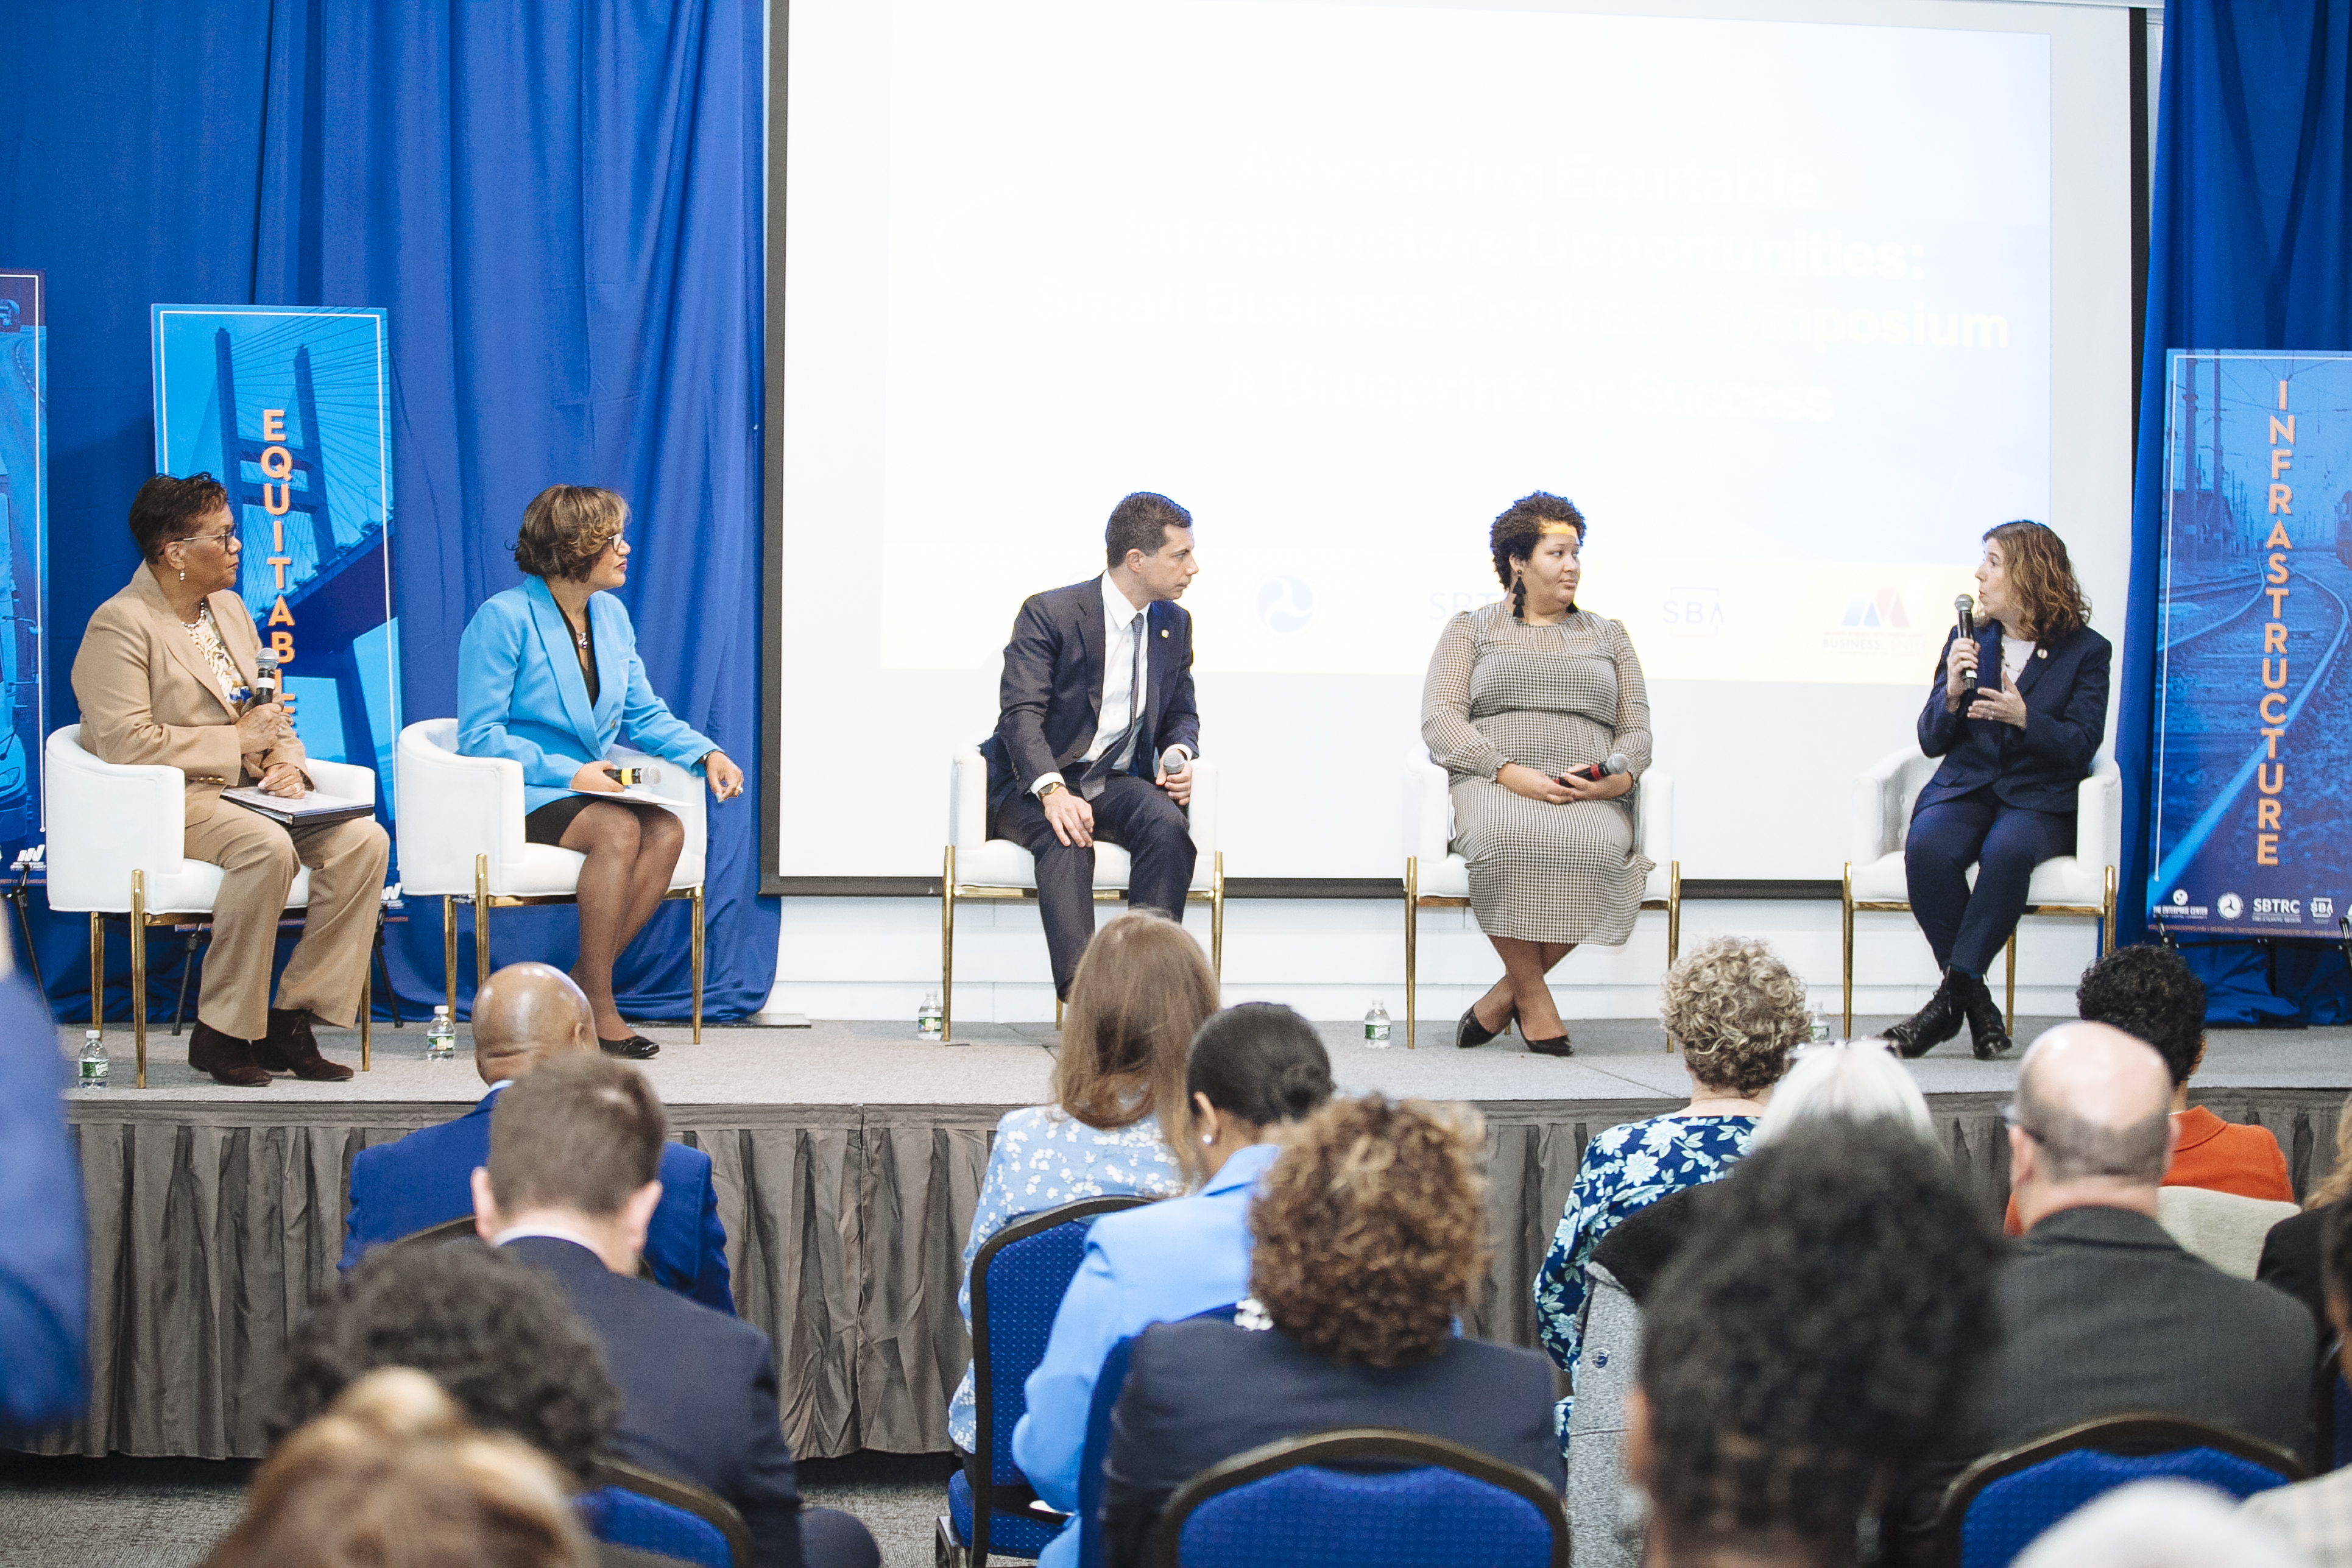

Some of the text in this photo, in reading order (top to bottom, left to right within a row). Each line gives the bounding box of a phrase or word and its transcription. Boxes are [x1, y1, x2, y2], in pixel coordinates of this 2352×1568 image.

[1693, 292, 2009, 353] Symposium
[1662, 600, 1725, 625] SBA
[2256, 380, 2296, 866] INFRASTRUCTURE
[2253, 898, 2301, 914] SBTRC
